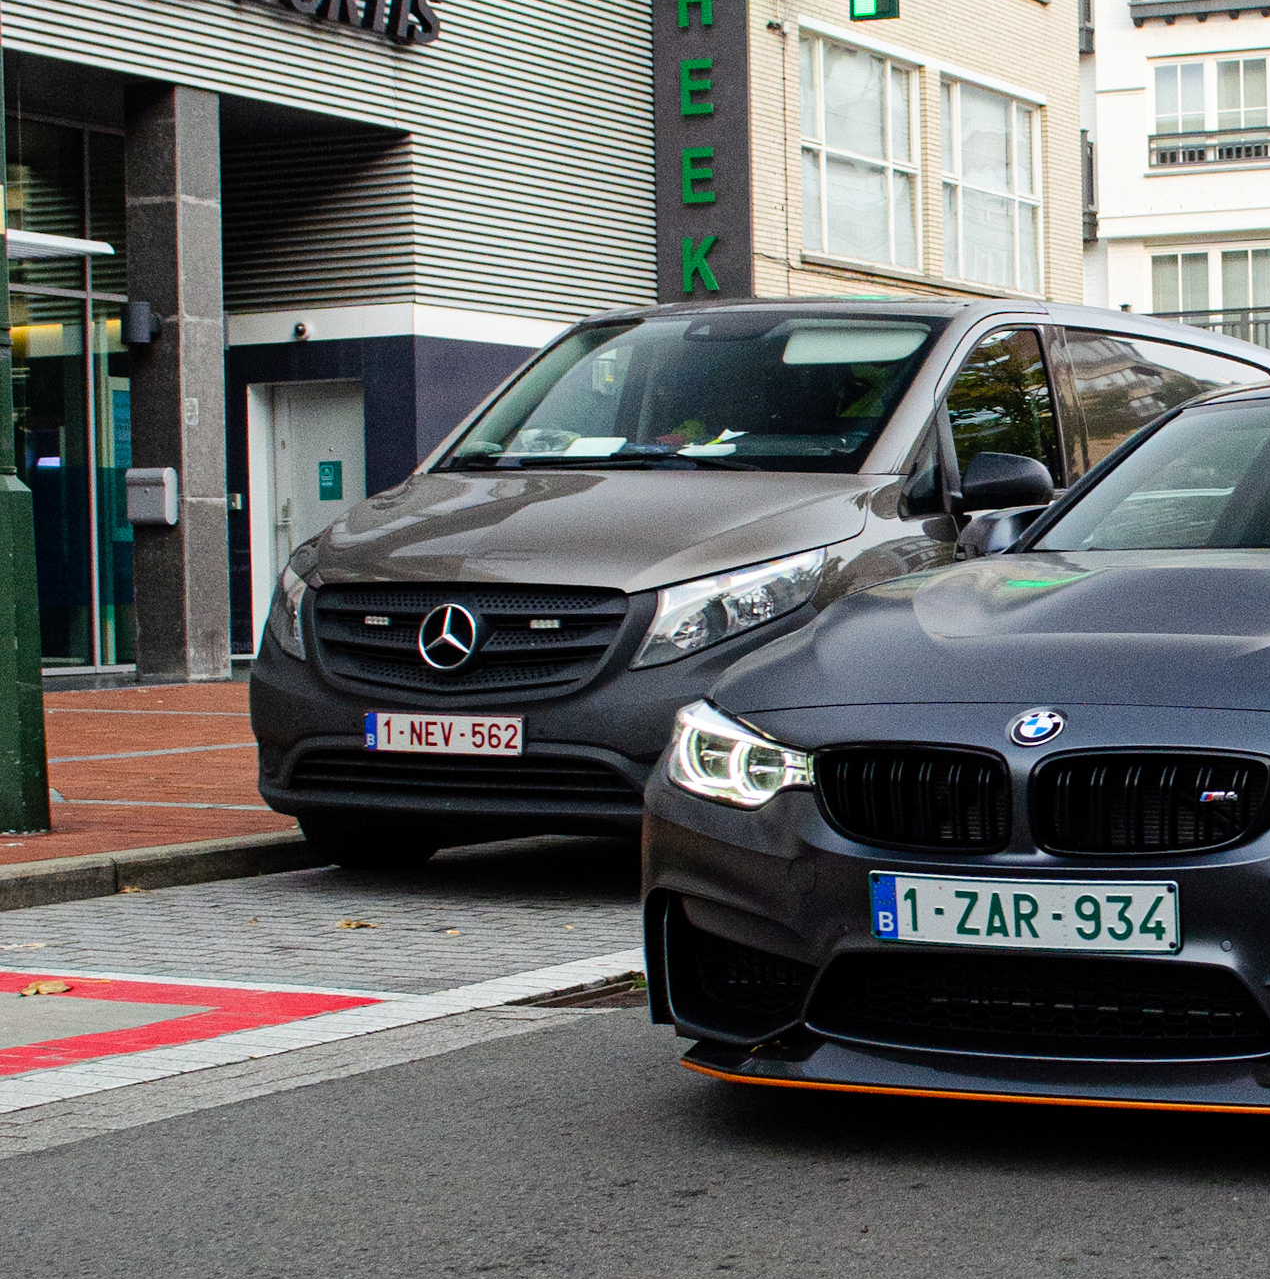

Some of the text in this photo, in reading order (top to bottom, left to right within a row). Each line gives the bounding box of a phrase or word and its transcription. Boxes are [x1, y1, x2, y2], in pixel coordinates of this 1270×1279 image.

[367, 733, 375, 746] B
[383, 716, 518, 750] 1-NEV-562
[877, 911, 894, 932] B
[903, 887, 1166, 941] 1-ZAR-934
